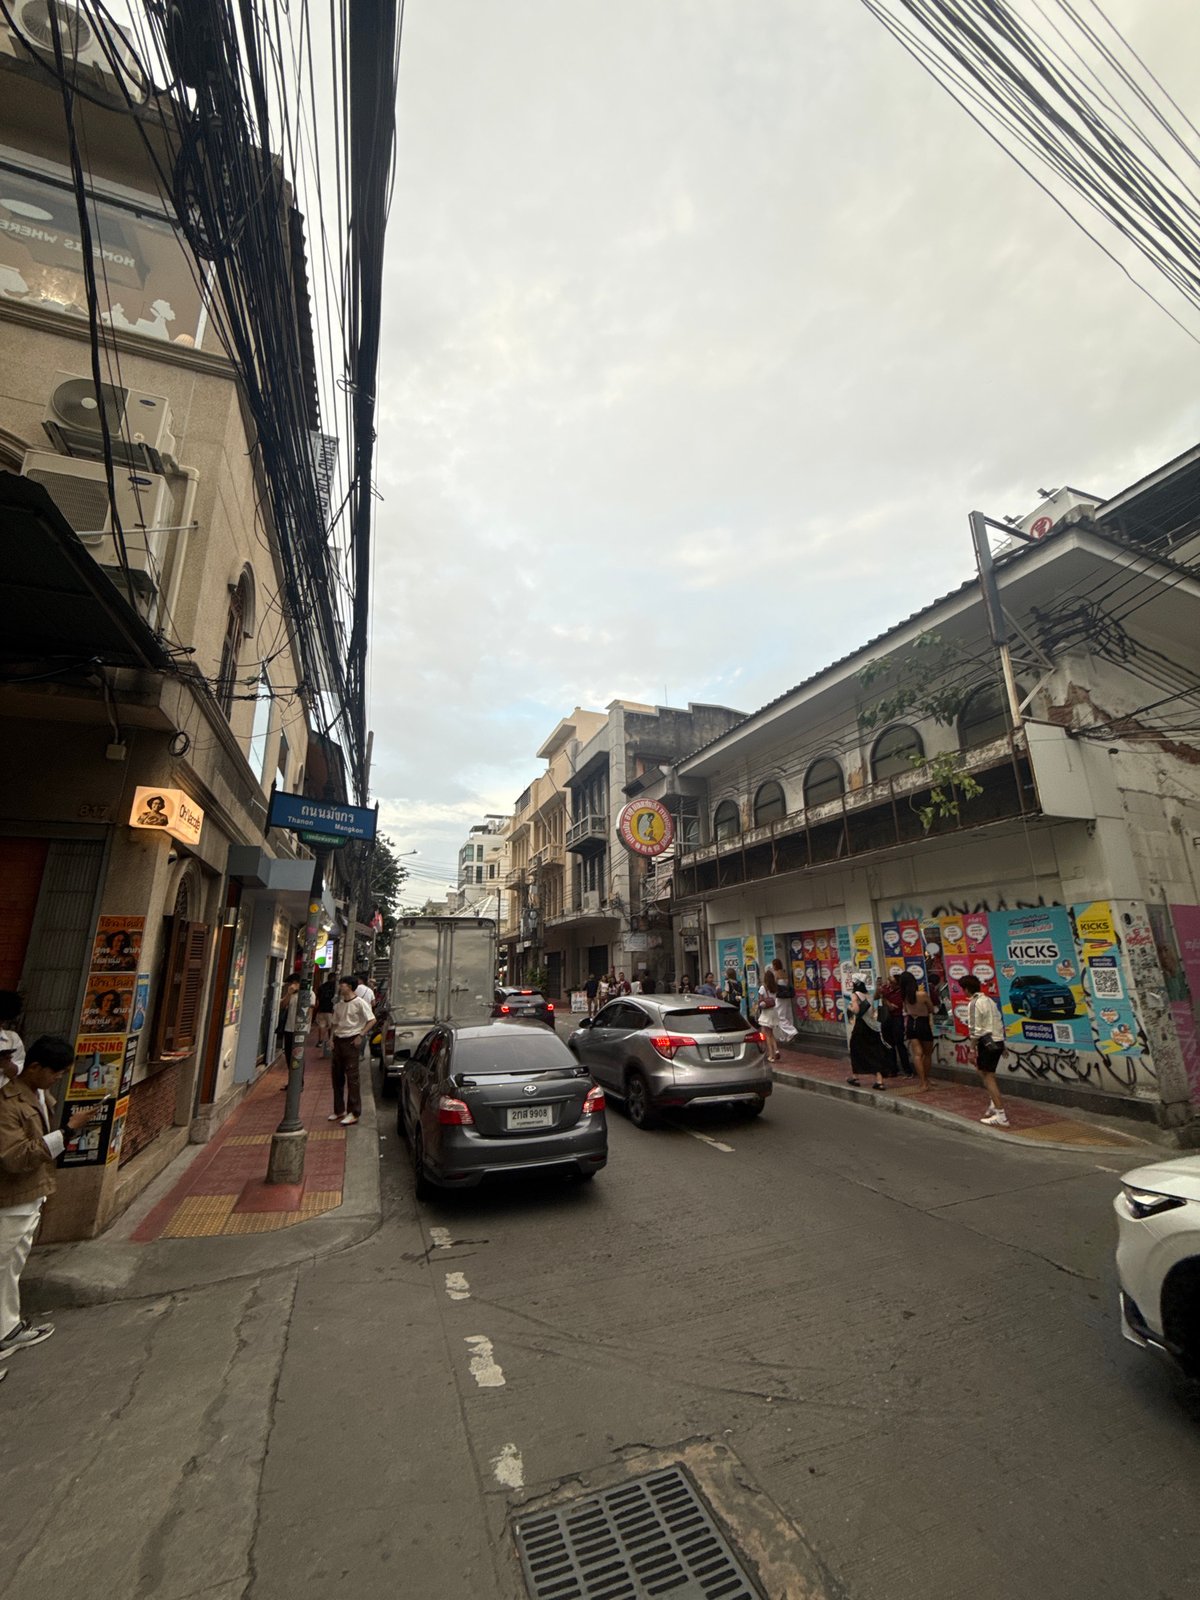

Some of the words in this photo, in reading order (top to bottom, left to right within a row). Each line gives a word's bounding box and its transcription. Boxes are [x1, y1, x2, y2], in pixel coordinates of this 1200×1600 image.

[301, 805, 355, 823] ถนนมังกร
[287, 816, 314, 826] Thanon
[334, 823, 364, 834] Mangkon
[1080, 922, 1109, 931] KICKS
[1008, 945, 1059, 959] KICKS
[77, 1041, 123, 1053] MISSING
